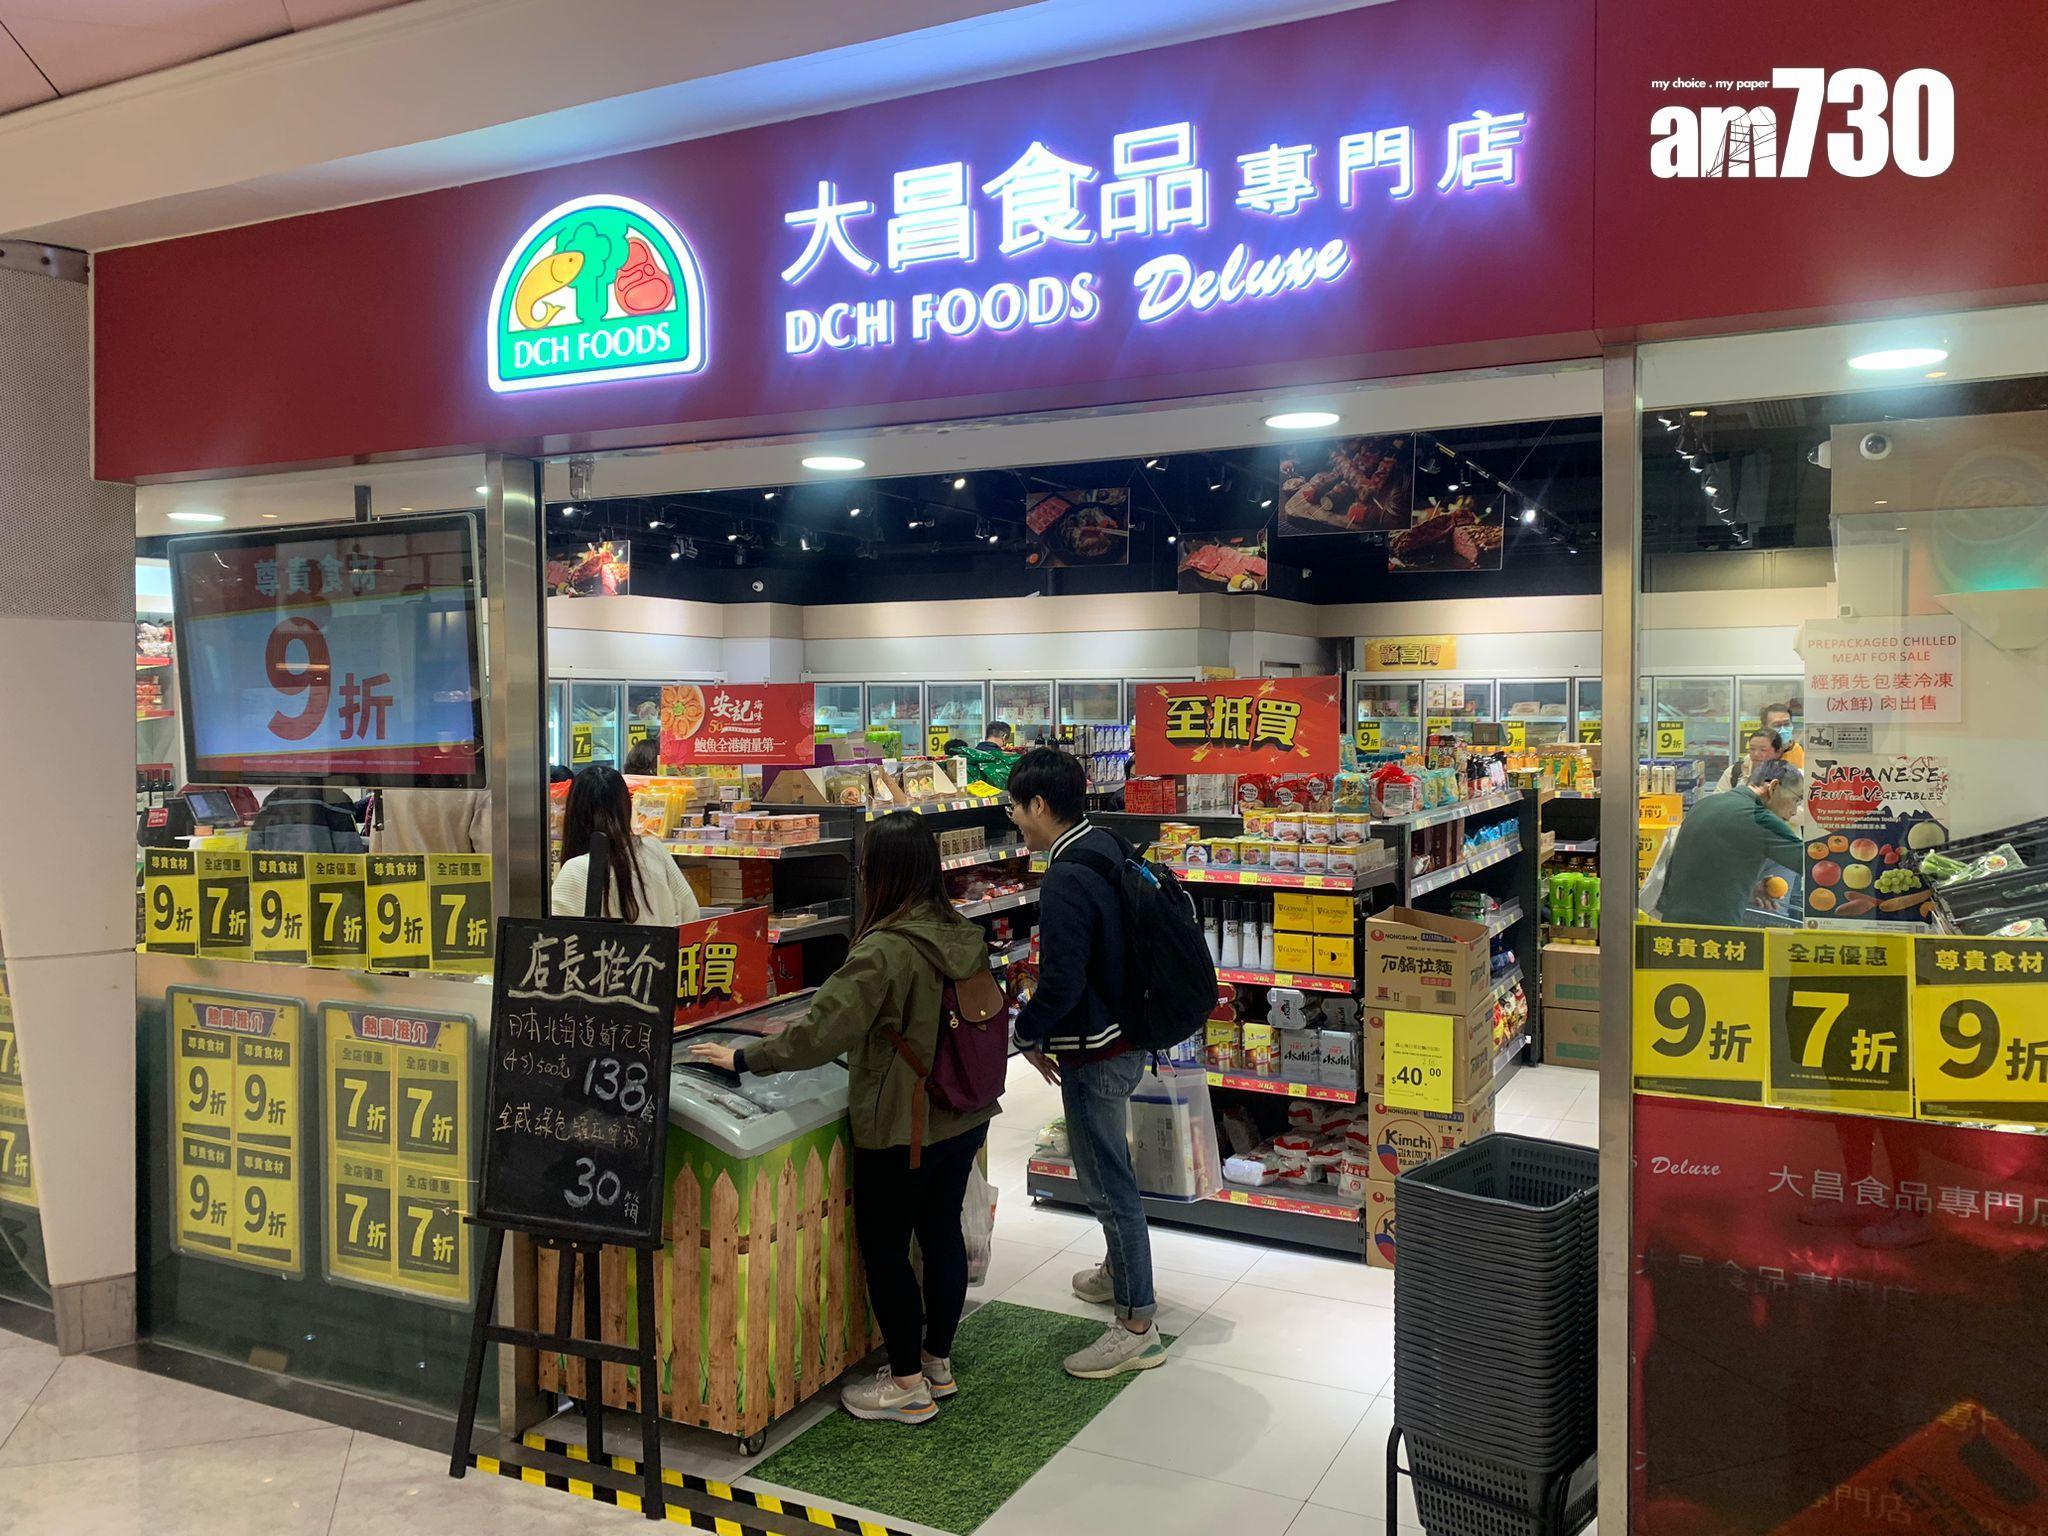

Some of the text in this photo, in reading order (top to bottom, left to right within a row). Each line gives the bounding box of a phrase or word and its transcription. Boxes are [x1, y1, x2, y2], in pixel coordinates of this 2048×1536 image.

[781, 110, 1528, 285] 大昌食品專門店
[784, 238, 1352, 356] DCH FOODS Deluxe
[513, 321, 672, 369] DCH FOODS
[1378, 643, 1442, 667] 驚喜價
[1808, 635, 1957, 649] PREPACKAGED CHILLED
[1832, 651, 1931, 664] MEAT FOR SALE
[264, 617, 393, 741] 9折
[1811, 672, 1954, 690] 經預先包裝冷凍
[1165, 695, 1301, 752] 至抵買
[153, 884, 193, 933] 9折
[207, 887, 247, 937] 7折
[261, 890, 303, 940] 9折
[319, 892, 363, 944] 7折
[377, 893, 424, 945] 9折
[440, 894, 488, 948] 7折
[519, 932, 666, 1004] 店長推介
[1381, 954, 1453, 976] 石鍋拉麵
[1653, 936, 1747, 962] 尊貴食材
[1788, 943, 1888, 967] 全店優惠
[1935, 950, 2045, 974] 尊貴食材
[1652, 983, 1753, 1064] 9折
[1792, 990, 1898, 1074] 7折
[1939, 999, 2048, 1083] 9折
[1284, 1050, 1310, 1062] Asahi
[1322, 1053, 1350, 1066] Asahi
[188, 1066, 227, 1117] 9折
[244, 1074, 287, 1125] 9折
[343, 1078, 387, 1133] 7折
[583, 1057, 648, 1112] 138
[407, 1087, 454, 1144] 7折
[1385, 1128, 1432, 1149] Kimchi
[564, 1157, 621, 1209] 30
[1651, 1155, 1721, 1177] Deluxe
[189, 1174, 228, 1227] 9折
[244, 1185, 287, 1238] 9折
[344, 1193, 387, 1250] 7折
[1383, 1218, 1395, 1234] K
[407, 1206, 455, 1263] 7折
